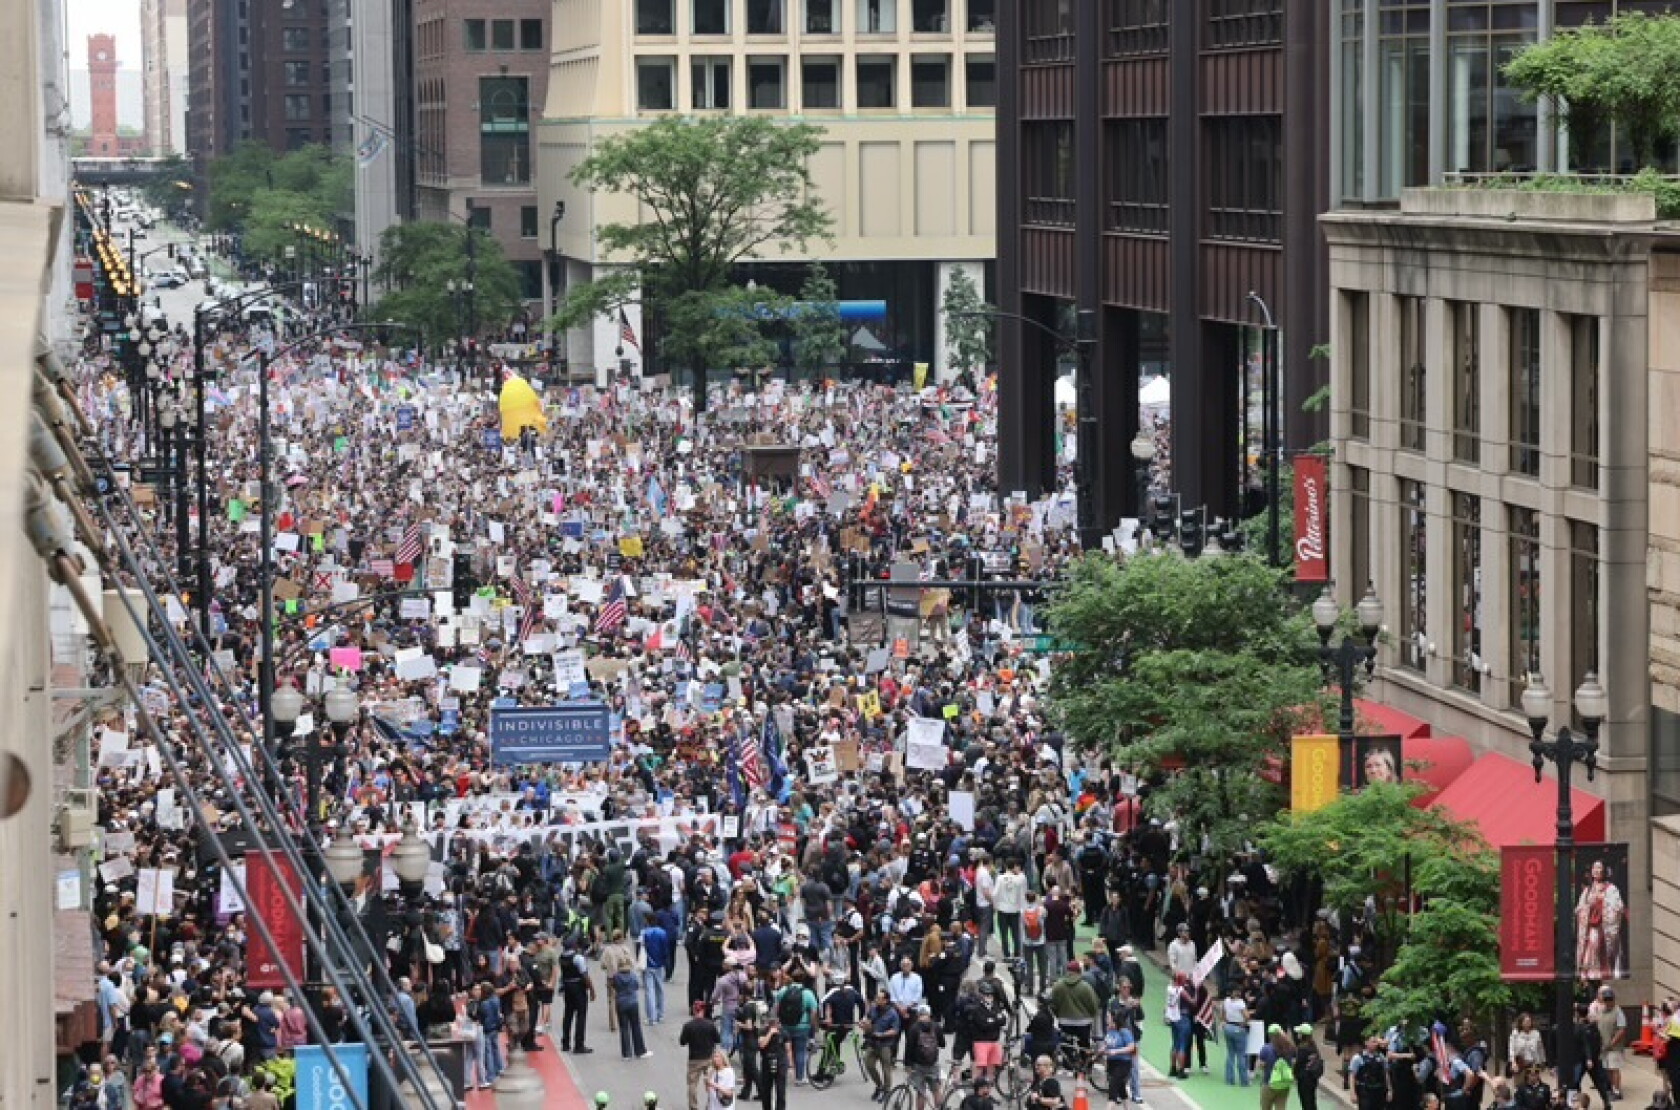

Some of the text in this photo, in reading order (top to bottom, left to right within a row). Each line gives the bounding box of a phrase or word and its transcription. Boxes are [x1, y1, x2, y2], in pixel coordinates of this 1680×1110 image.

[499, 719, 603, 731] INDIVISIBLE
[520, 733, 584, 744] CHICAGO
[1524, 858, 1542, 951] GOODMAN
